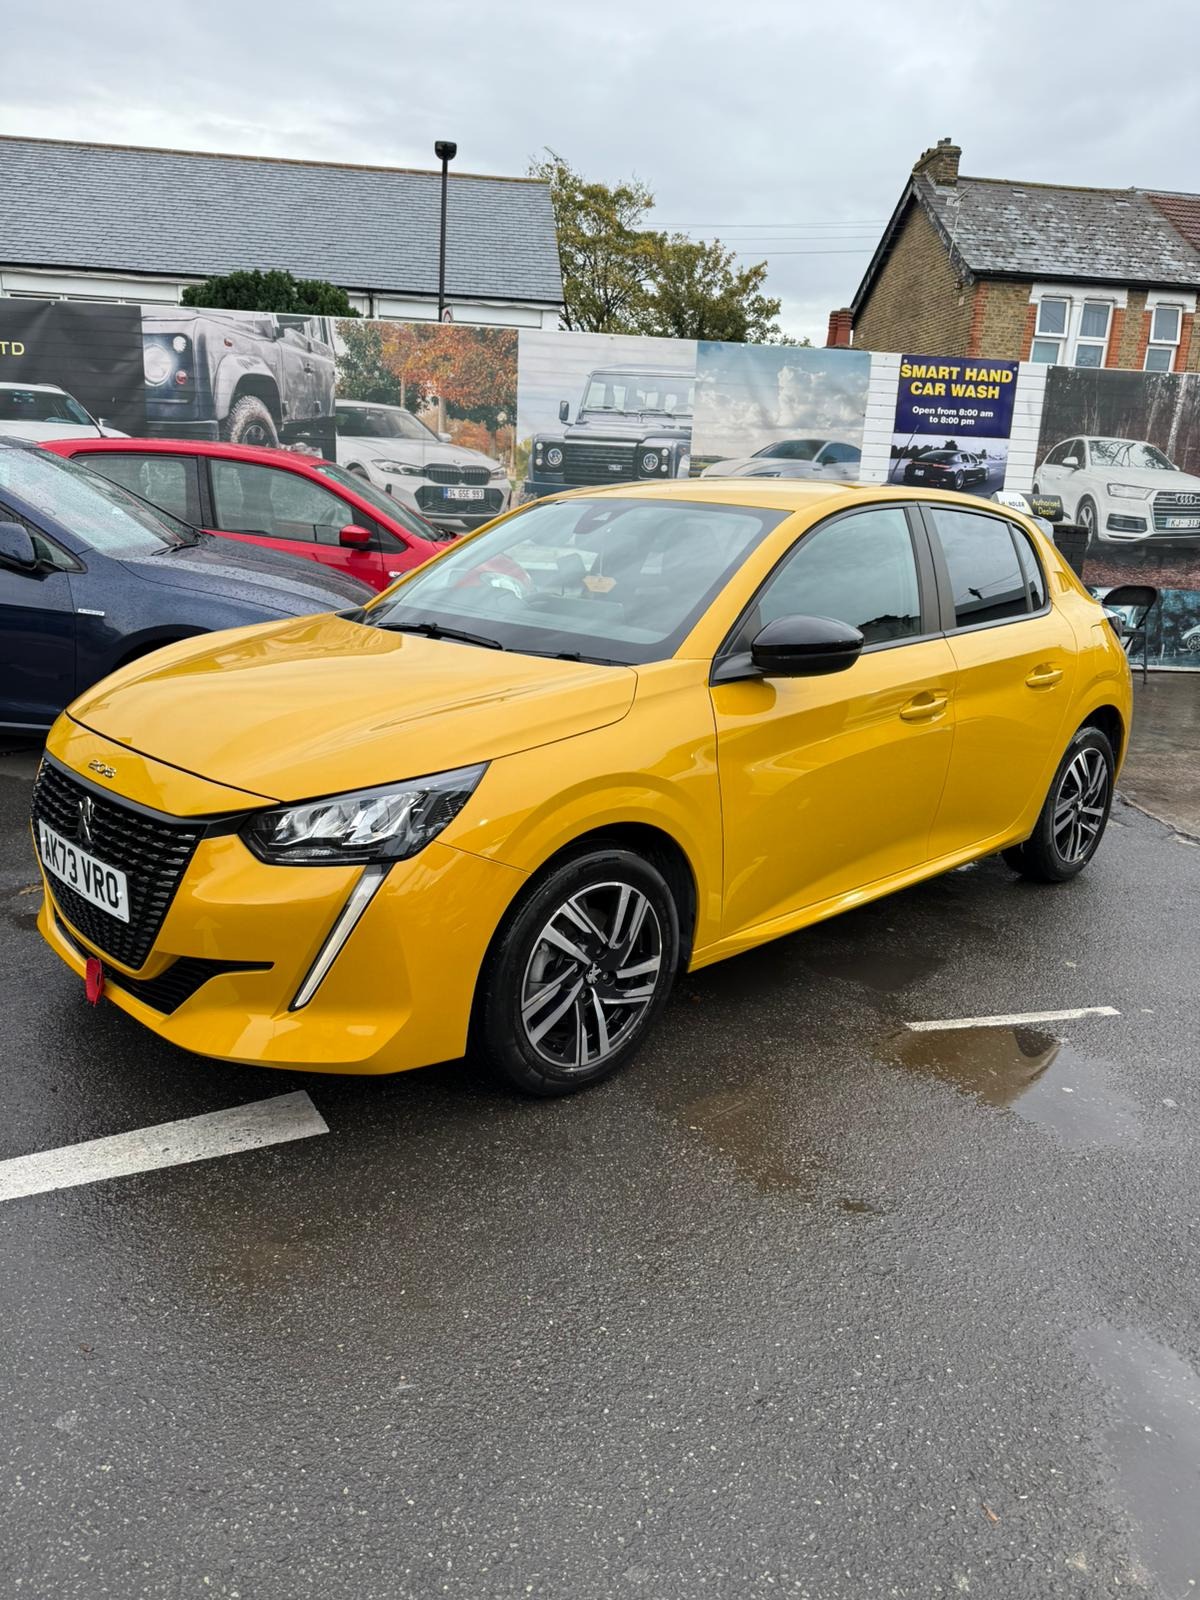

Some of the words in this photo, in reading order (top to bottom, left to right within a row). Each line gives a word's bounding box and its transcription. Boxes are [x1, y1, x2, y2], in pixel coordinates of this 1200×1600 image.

[900, 364, 961, 380] SMART
[965, 367, 1013, 384] HAND
[910, 381, 946, 396] CAR
[951, 383, 1000, 399] WASH
[912, 405, 936, 416] Open
[937, 406, 957, 416] from
[958, 408, 978, 417] 8:00
[929, 415, 938, 423] to
[940, 416, 959, 425] 8:00
[960, 418, 975, 427] pm
[88, 759, 117, 779] 208
[45, 829, 78, 885] AK73
[81, 855, 119, 909] VRO
